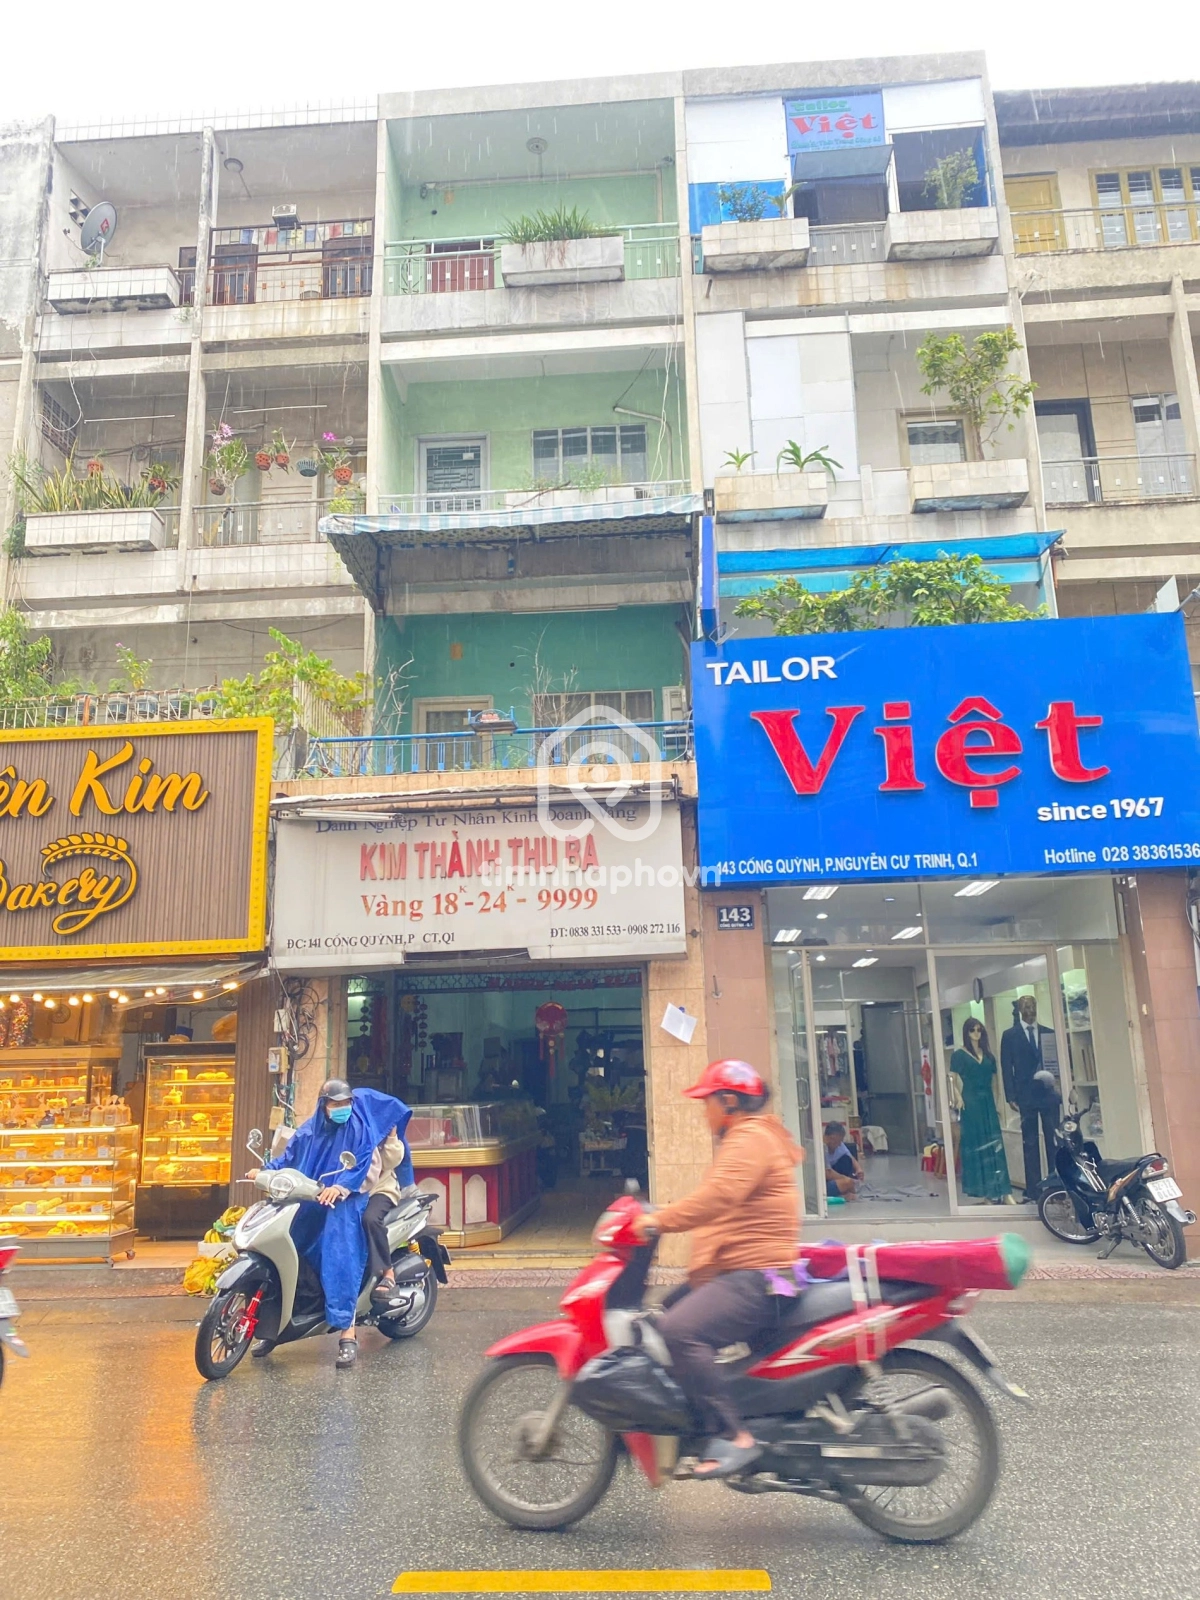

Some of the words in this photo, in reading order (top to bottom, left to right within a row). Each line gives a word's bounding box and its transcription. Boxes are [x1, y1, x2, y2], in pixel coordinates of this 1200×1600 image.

[789, 113, 879, 139] Việt
[706, 655, 838, 686] TAILOR
[750, 696, 1111, 808] Việt
[69, 740, 209, 817] Kim
[422, 814, 447, 828] Tư
[453, 811, 496, 827] Nhân
[502, 809, 539, 824] Kinh
[546, 807, 592, 822] Doanh
[1037, 802, 1107, 822] since
[1110, 797, 1164, 818] 1967
[360, 842, 407, 880] KIM
[414, 830, 500, 879] THÀNH
[507, 837, 557, 875] THU
[565, 834, 600, 872] BA
[716, 860, 736, 876] 143
[738, 857, 774, 875] CỐNG
[776, 856, 824, 874] QUỲNH,
[825, 852, 888, 872] P.NGUYỄN
[890, 854, 911, 870] CƯ
[957, 852, 978, 869] Q.1
[1044, 847, 1097, 864] Hotline
[1102, 846, 1130, 862] 028
[1132, 843, 1200, 861] 38361536
[360, 893, 424, 922] Vàng
[537, 887, 599, 911] 9999
[720, 907, 751, 922] 143
[324, 933, 358, 948] CỐNG
[569, 926, 589, 938] 0838
[591, 925, 605, 937] 331
[606, 925, 621, 936] 533
[628, 924, 649, 936] 0908
[650, 923, 664, 934] 272
[667, 923, 681, 934] 116
